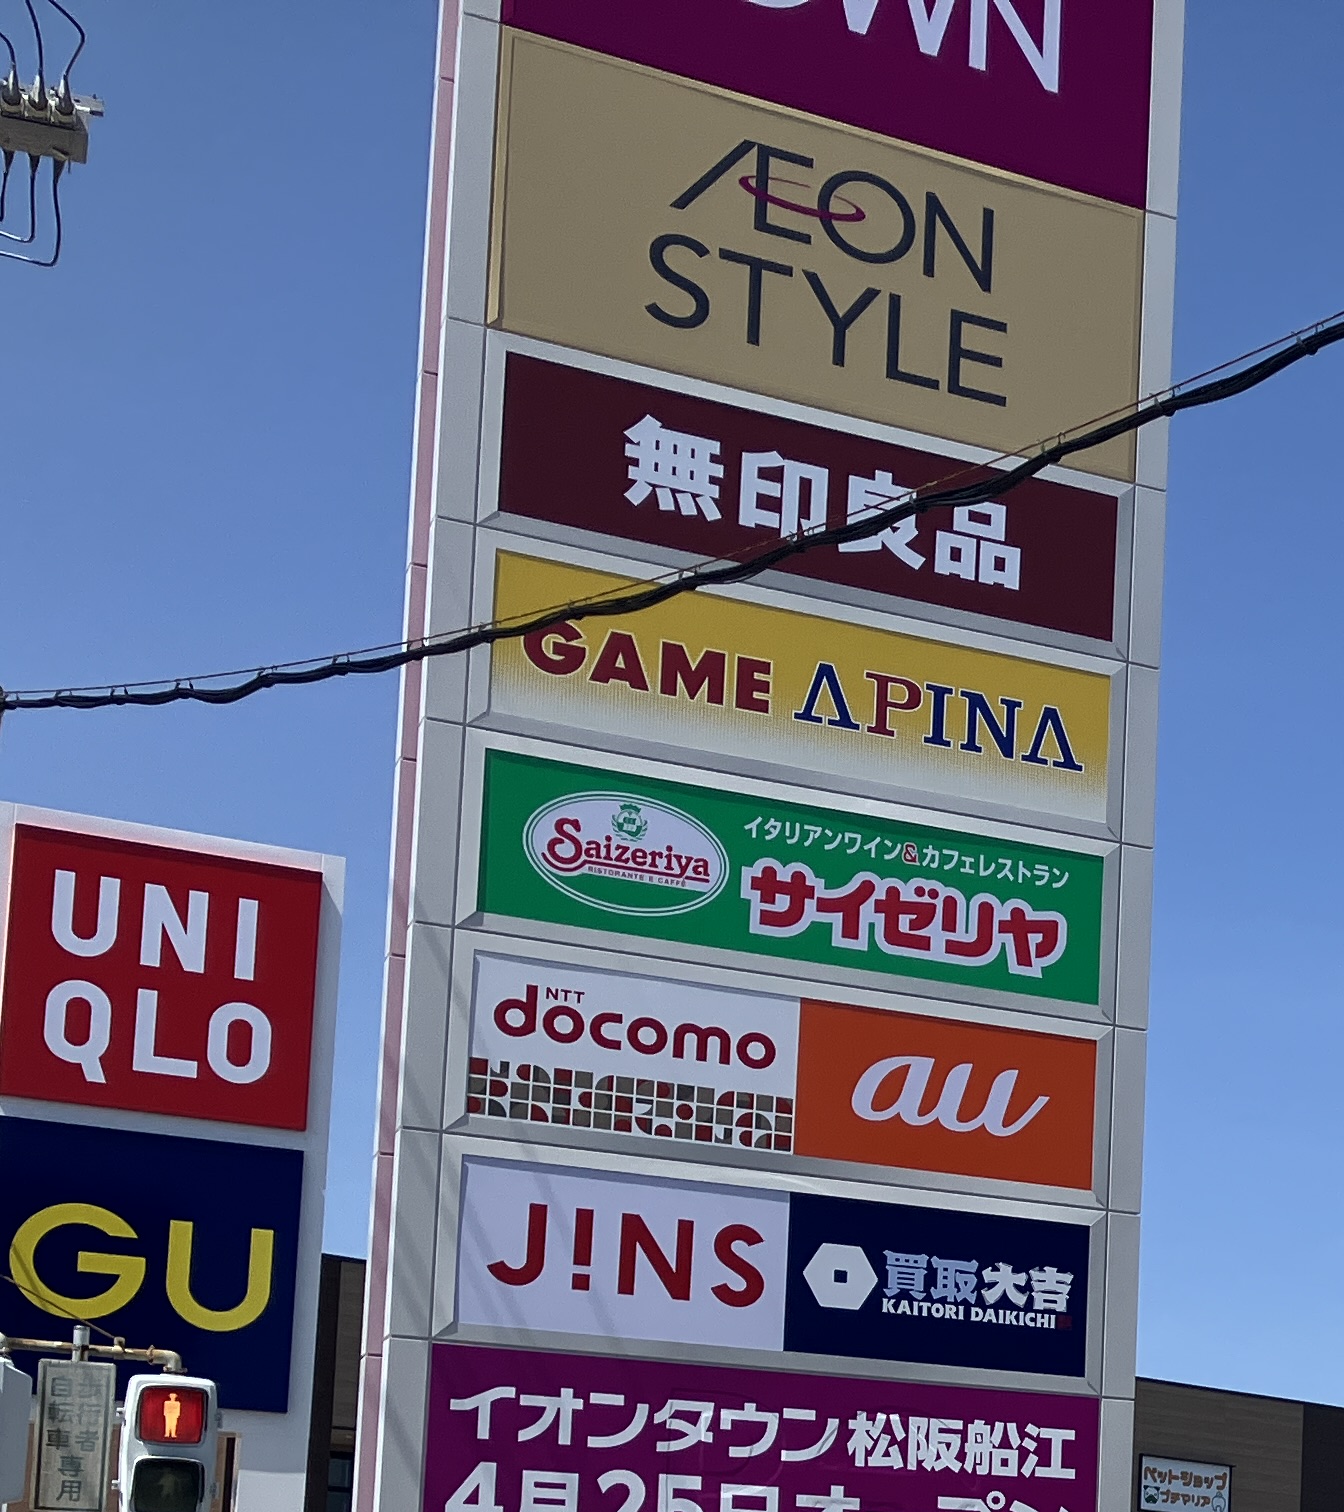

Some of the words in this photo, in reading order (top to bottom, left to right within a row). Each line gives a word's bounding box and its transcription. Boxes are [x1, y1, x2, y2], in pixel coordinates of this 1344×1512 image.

[644, 234, 1008, 407] STYLE
[623, 414, 1021, 590] 無印良品
[522, 619, 773, 715] GAME
[543, 817, 710, 878] Saizeriya
[587, 865, 644, 882] RISTORANTE
[51, 869, 258, 981] UNI
[749, 864, 1060, 968] サイゼリヤ
[42, 979, 273, 1084] QLO
[492, 984, 777, 1071] docomo
[545, 986, 585, 1005] NTT
[850, 1055, 1050, 1137] au
[9, 1203, 274, 1332] GU
[881, 1298, 965, 1320] KAITORI
[970, 1306, 1057, 1330] DAIKICHI
[882, 1250, 1074, 1312] 買取大吉
[450, 1385, 1076, 1480] イオンタウン松阪船江
